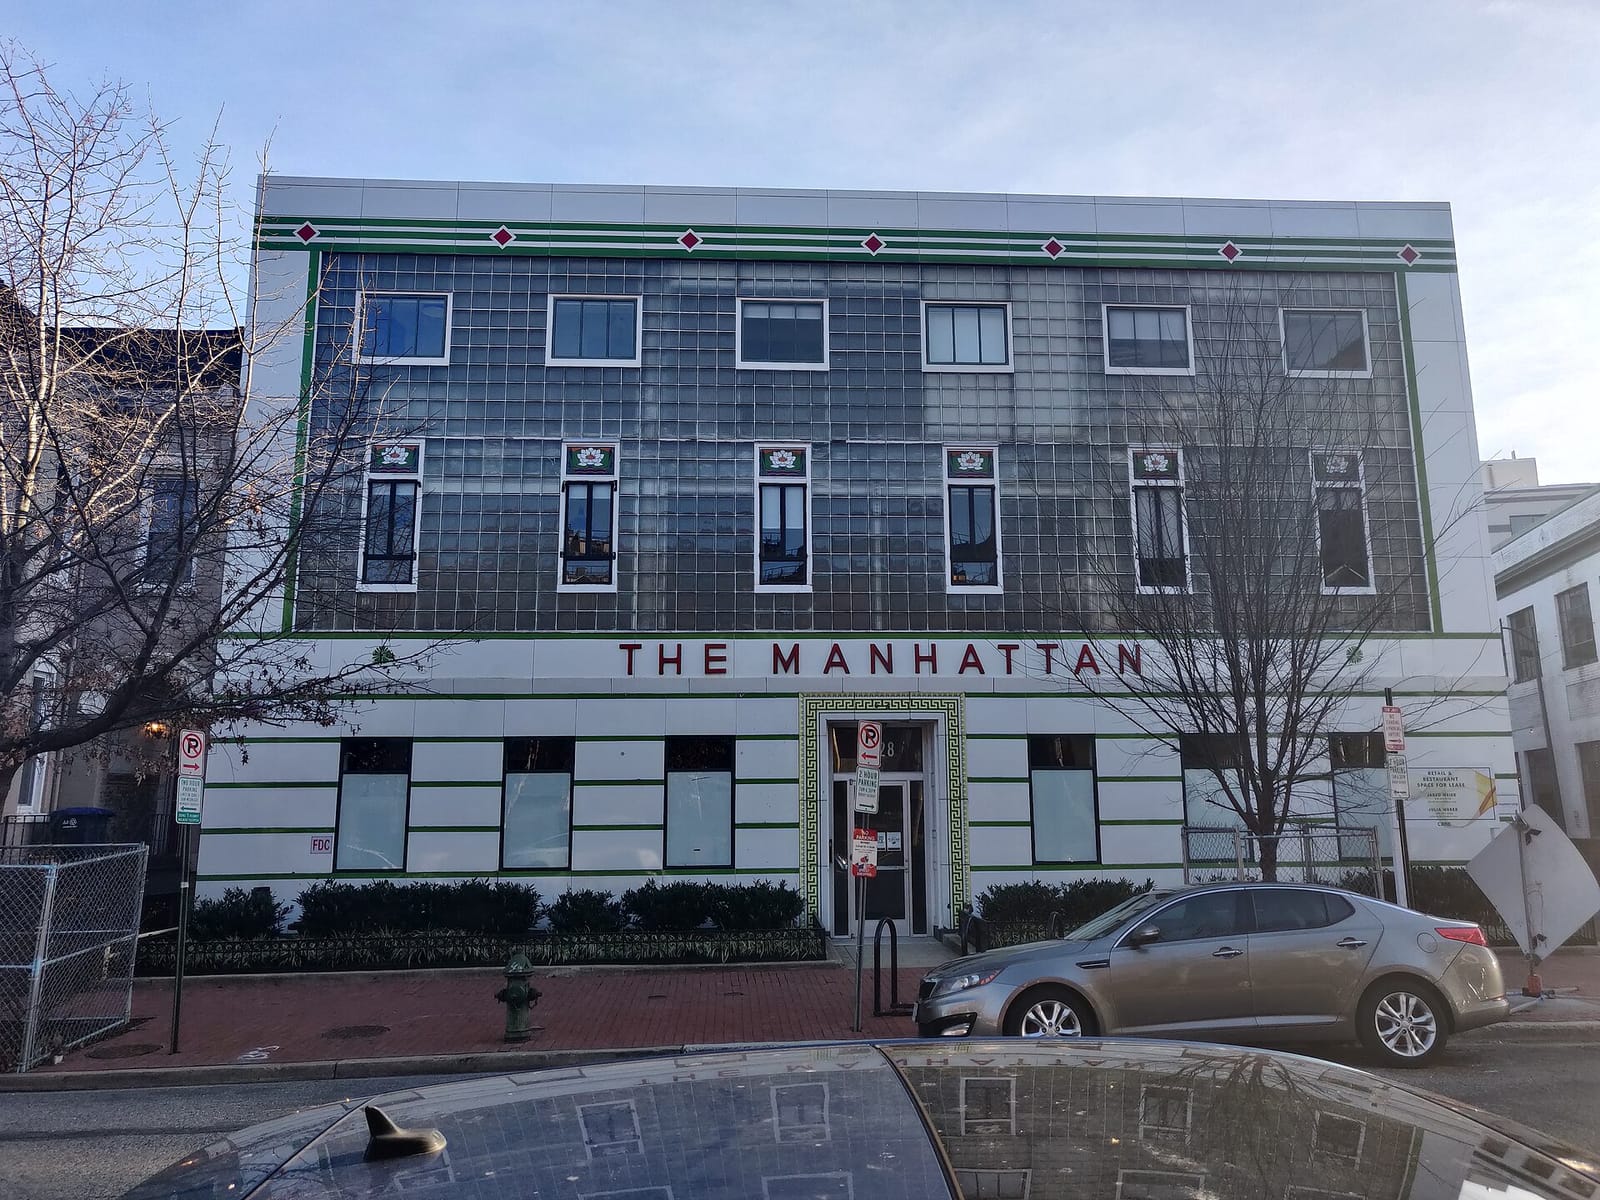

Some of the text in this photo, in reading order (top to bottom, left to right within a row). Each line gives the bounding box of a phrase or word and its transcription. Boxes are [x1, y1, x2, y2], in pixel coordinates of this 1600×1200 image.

[619, 643, 1142, 675] THE MANHATTAN
[864, 770, 878, 780] HOUR
[858, 778, 878, 789] PARKING
[312, 839, 331, 851] FDC
